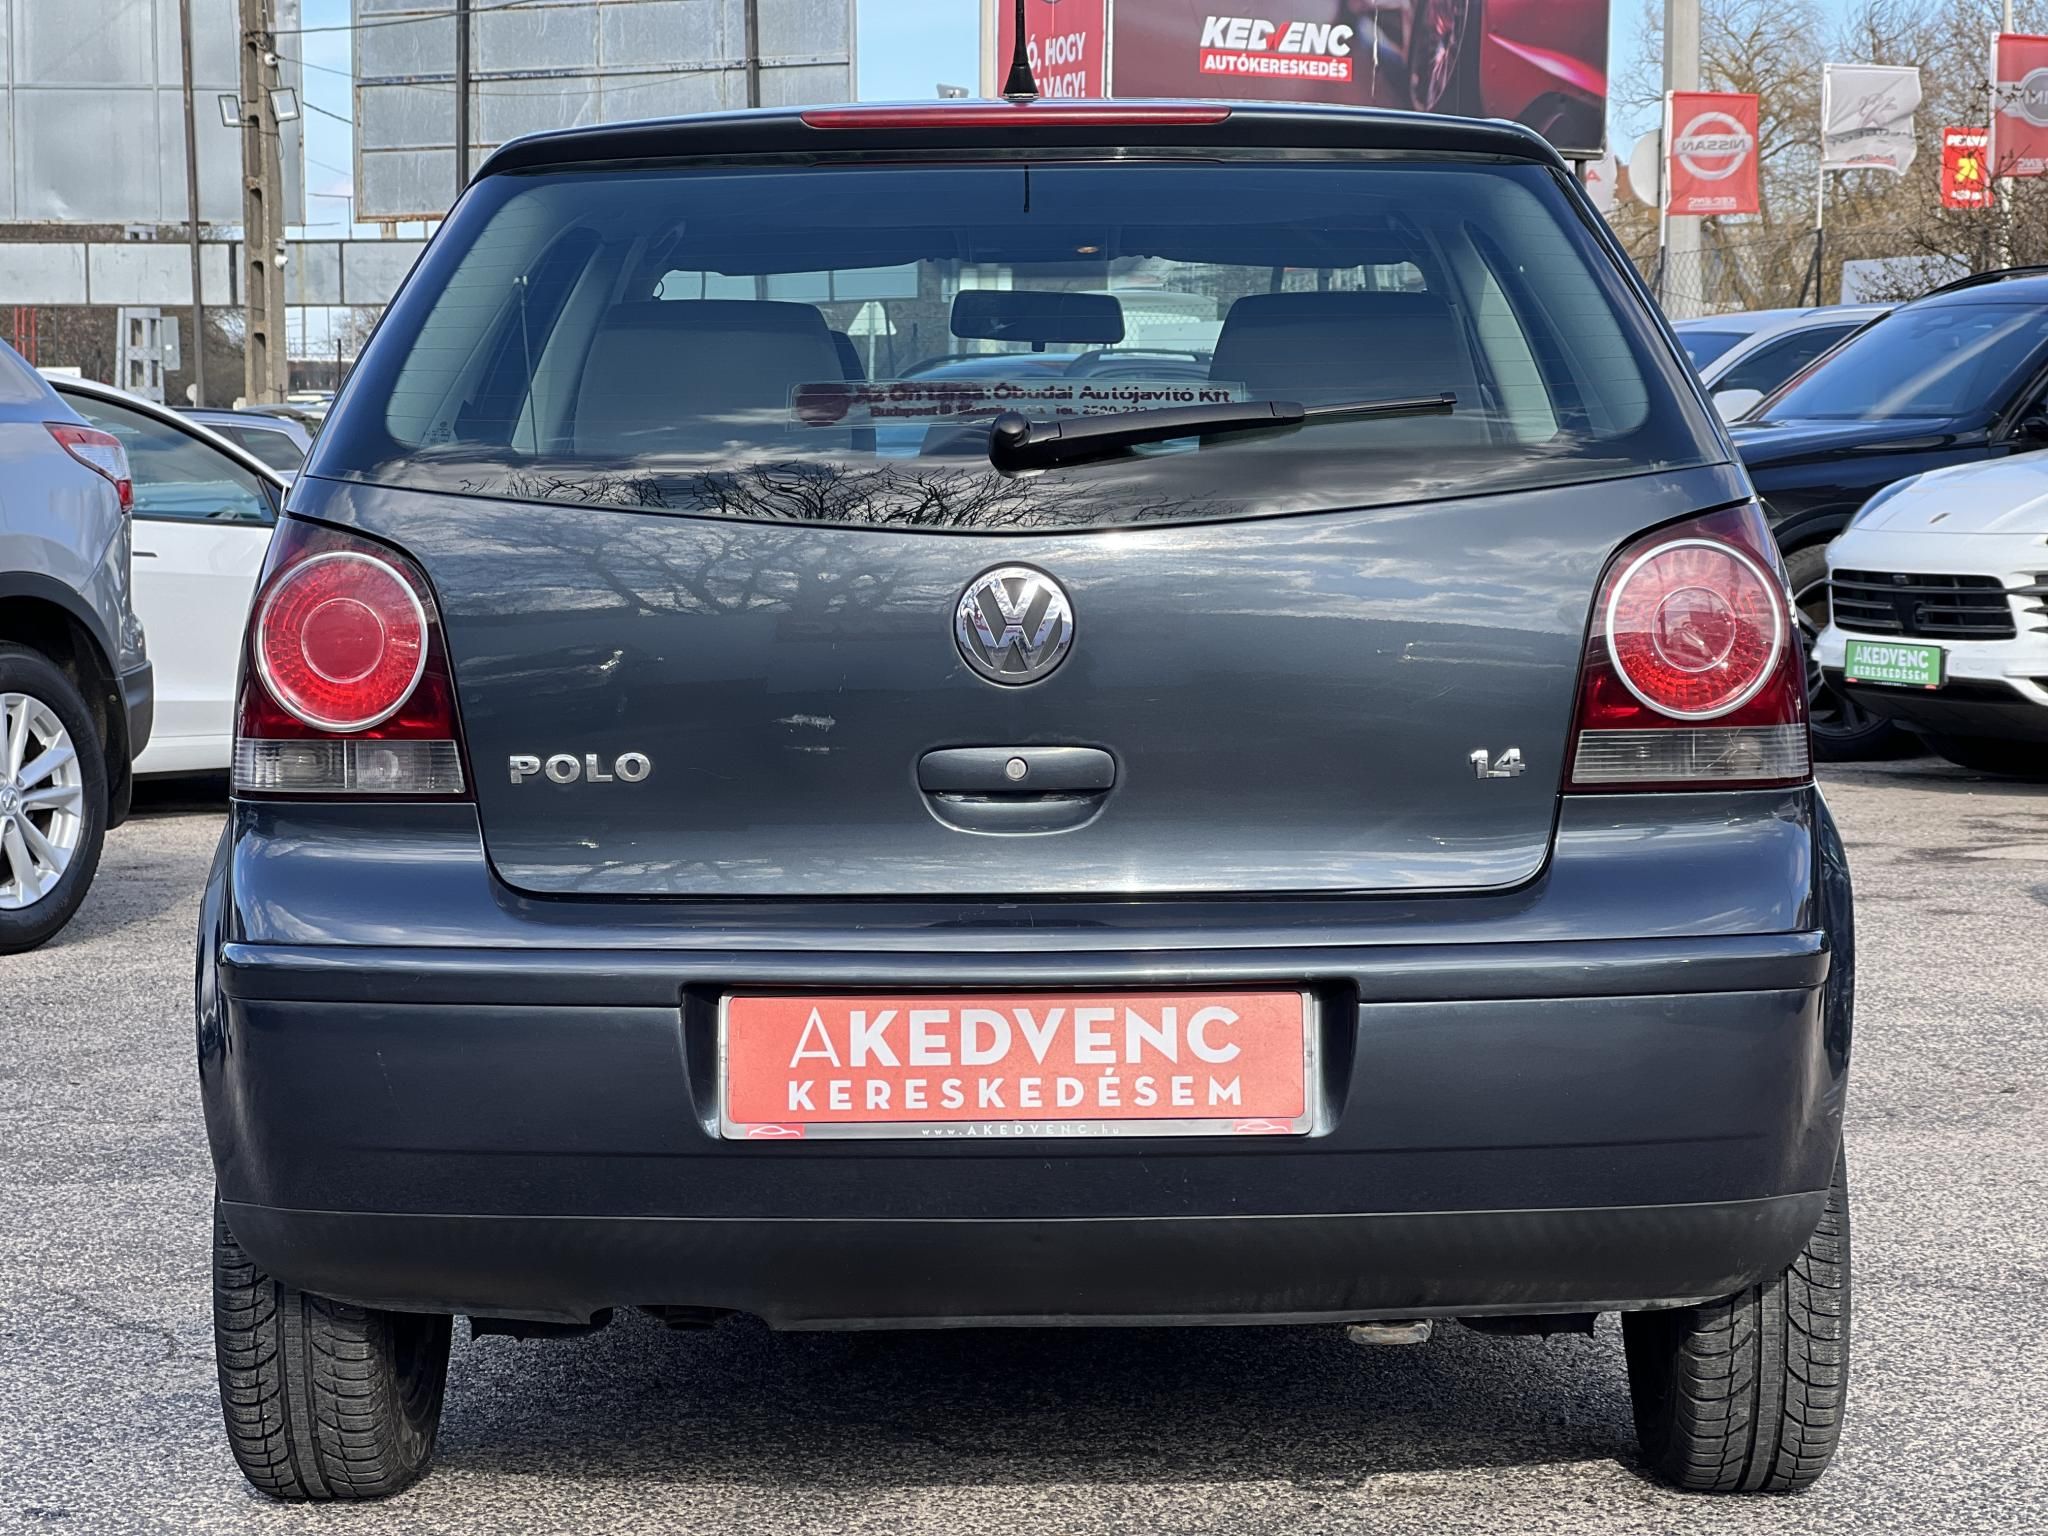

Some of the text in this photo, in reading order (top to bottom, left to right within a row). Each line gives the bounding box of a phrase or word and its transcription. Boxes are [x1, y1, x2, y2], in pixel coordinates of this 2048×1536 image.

[1045, 31, 1087, 66] HOGY
[1204, 53, 1349, 78] AUTÓKERESKEDÉS
[1042, 71, 1087, 98] VAGY!
[994, 382, 1074, 400] Óbudai
[1079, 385, 1195, 403] Autójavító
[1198, 388, 1235, 403] Kft.
[1854, 645, 1929, 669] AKEDVENC
[1853, 664, 1929, 681] KERESKEDÉSEM
[509, 752, 651, 784] POLO
[788, 1006, 1243, 1068] AKEDVENC
[788, 1069, 1243, 1111] KERESKEDÉSEM
[922, 1124, 1120, 1136] www.AKEDVENC.hu
